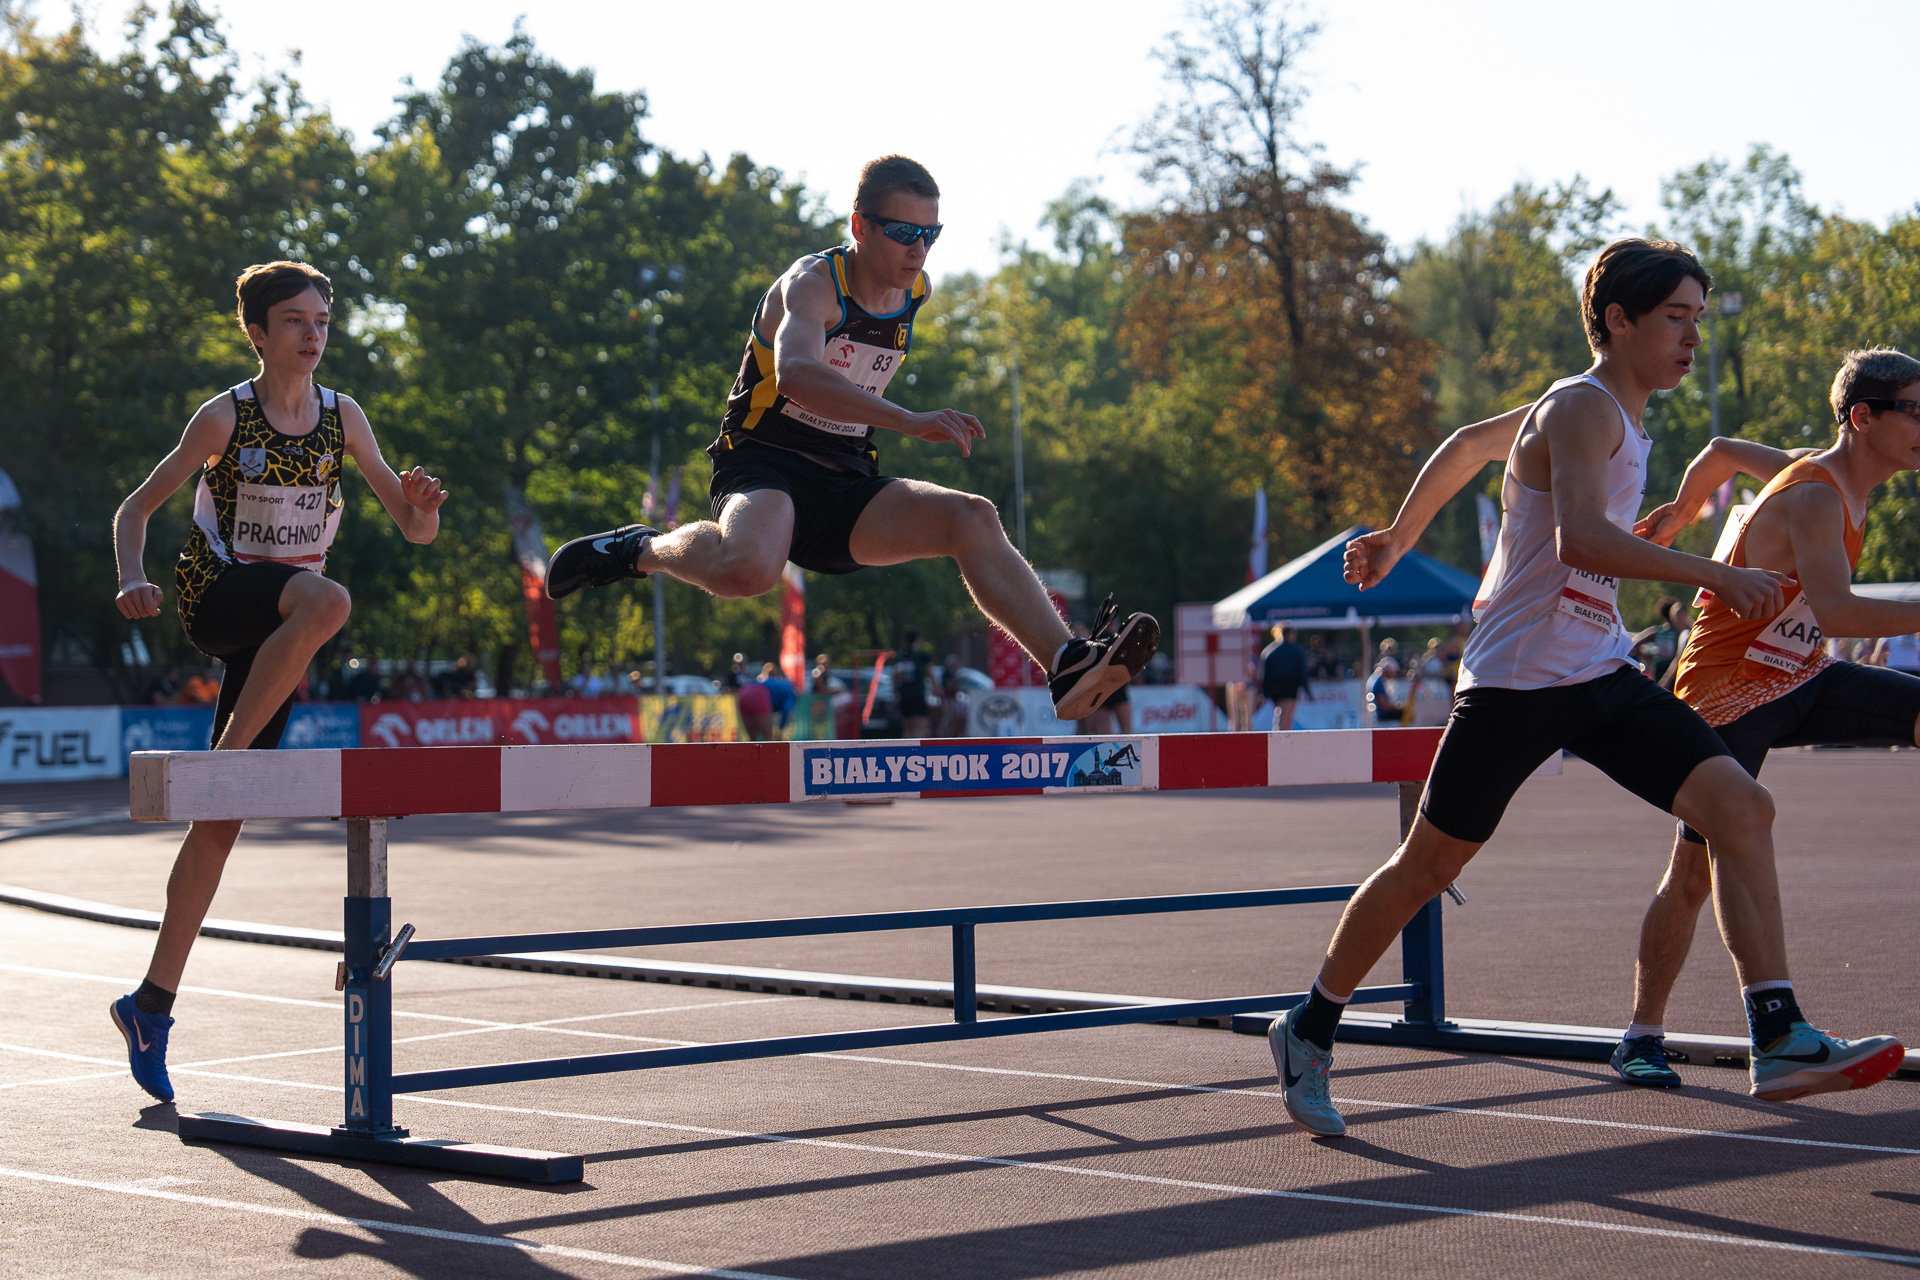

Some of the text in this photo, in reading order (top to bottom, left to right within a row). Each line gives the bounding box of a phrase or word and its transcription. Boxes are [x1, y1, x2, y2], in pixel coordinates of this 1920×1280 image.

[829, 358, 852, 369] ORLEN
[871, 353, 894, 373] 83
[798, 411, 857, 433] BIAŁYSTOK 2024
[240, 493, 285, 505] TVP SPORT
[294, 491, 323, 511] 427
[237, 520, 321, 546] PRACHNIO
[1573, 605, 1612, 627] BIAŁYSTO
[1763, 655, 1800, 672] BIAŁYS
[415, 715, 495, 743] ORLEN
[553, 711, 634, 741] ORLEN
[11, 730, 105, 768] FUEL
[811, 752, 1069, 785] BIAŁYSTOK 2017
[349, 993, 365, 1117] DIMA
